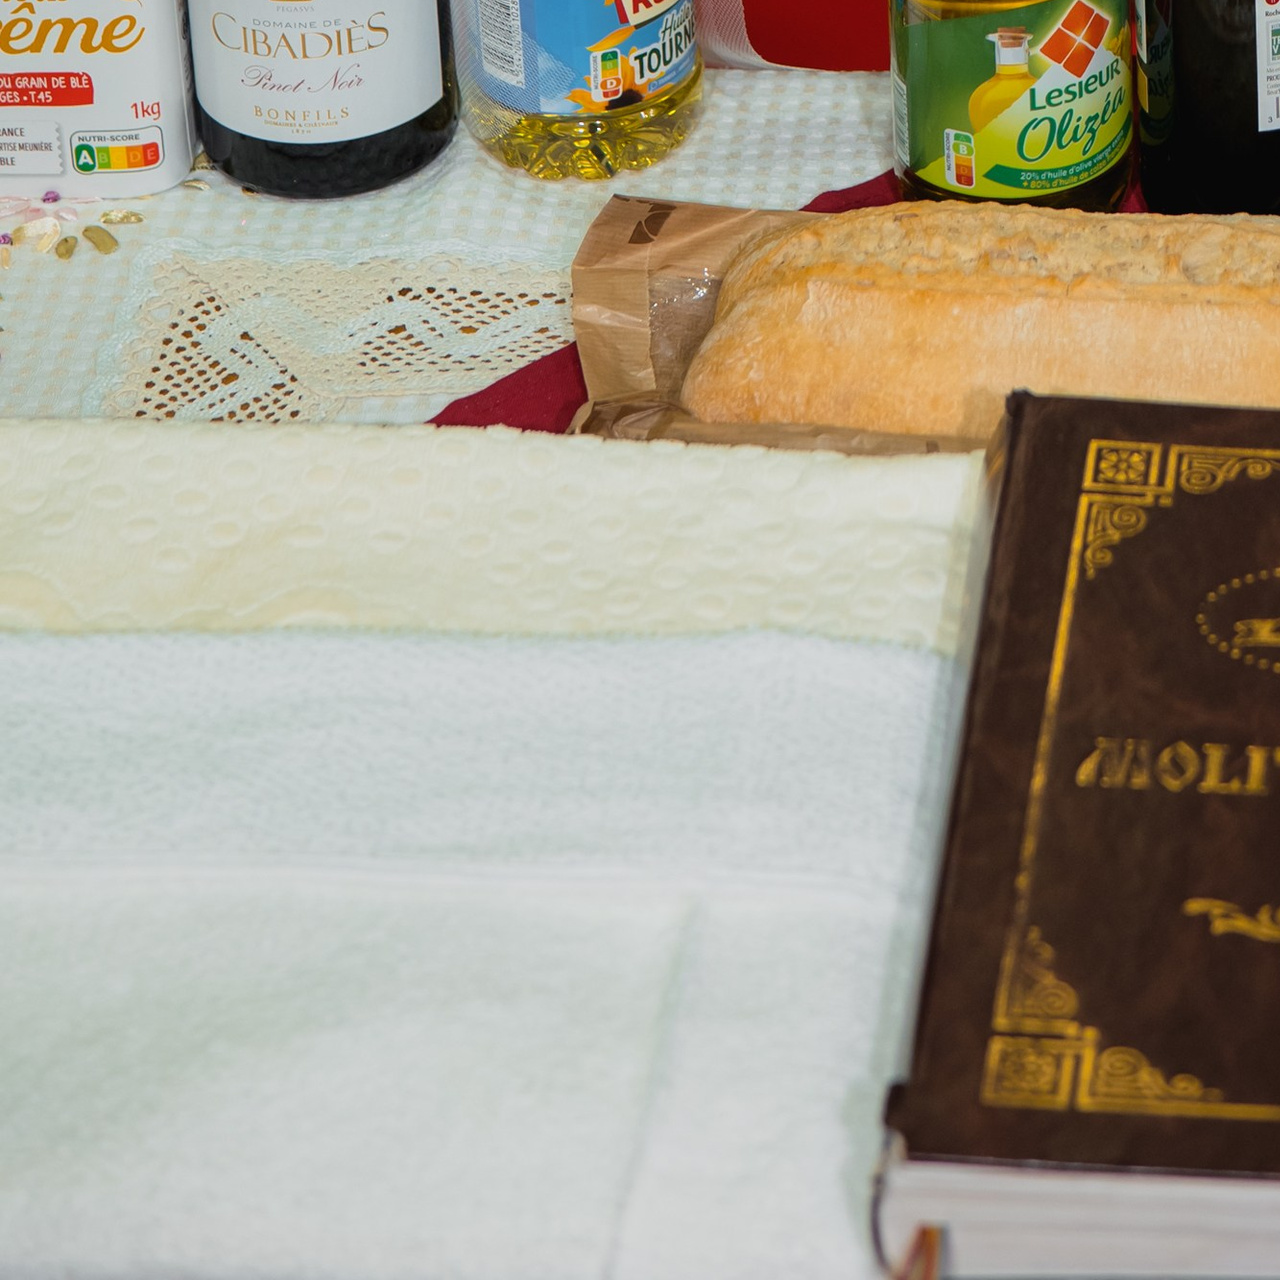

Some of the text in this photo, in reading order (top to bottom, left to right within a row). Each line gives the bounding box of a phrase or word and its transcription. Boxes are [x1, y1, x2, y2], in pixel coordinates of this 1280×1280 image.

[252, 18, 342, 28] DOMAINE DE
[211, 11, 389, 60] CIBADIÈS
[15, 77, 48, 89] GRAIN
[51, 77, 66, 89] DE
[70, 75, 90, 88] BLÉ
[240, 63, 366, 93] Pinot Noir
[29, 91, 52, 103] T.45
[131, 101, 161, 120] 1kg
[254, 105, 349, 121] BONFILS
[1016, 85, 1126, 163] Olizéa
[78, 133, 140, 142] NUTRI-SCORE
[1020, 172, 1039, 181] 20%
